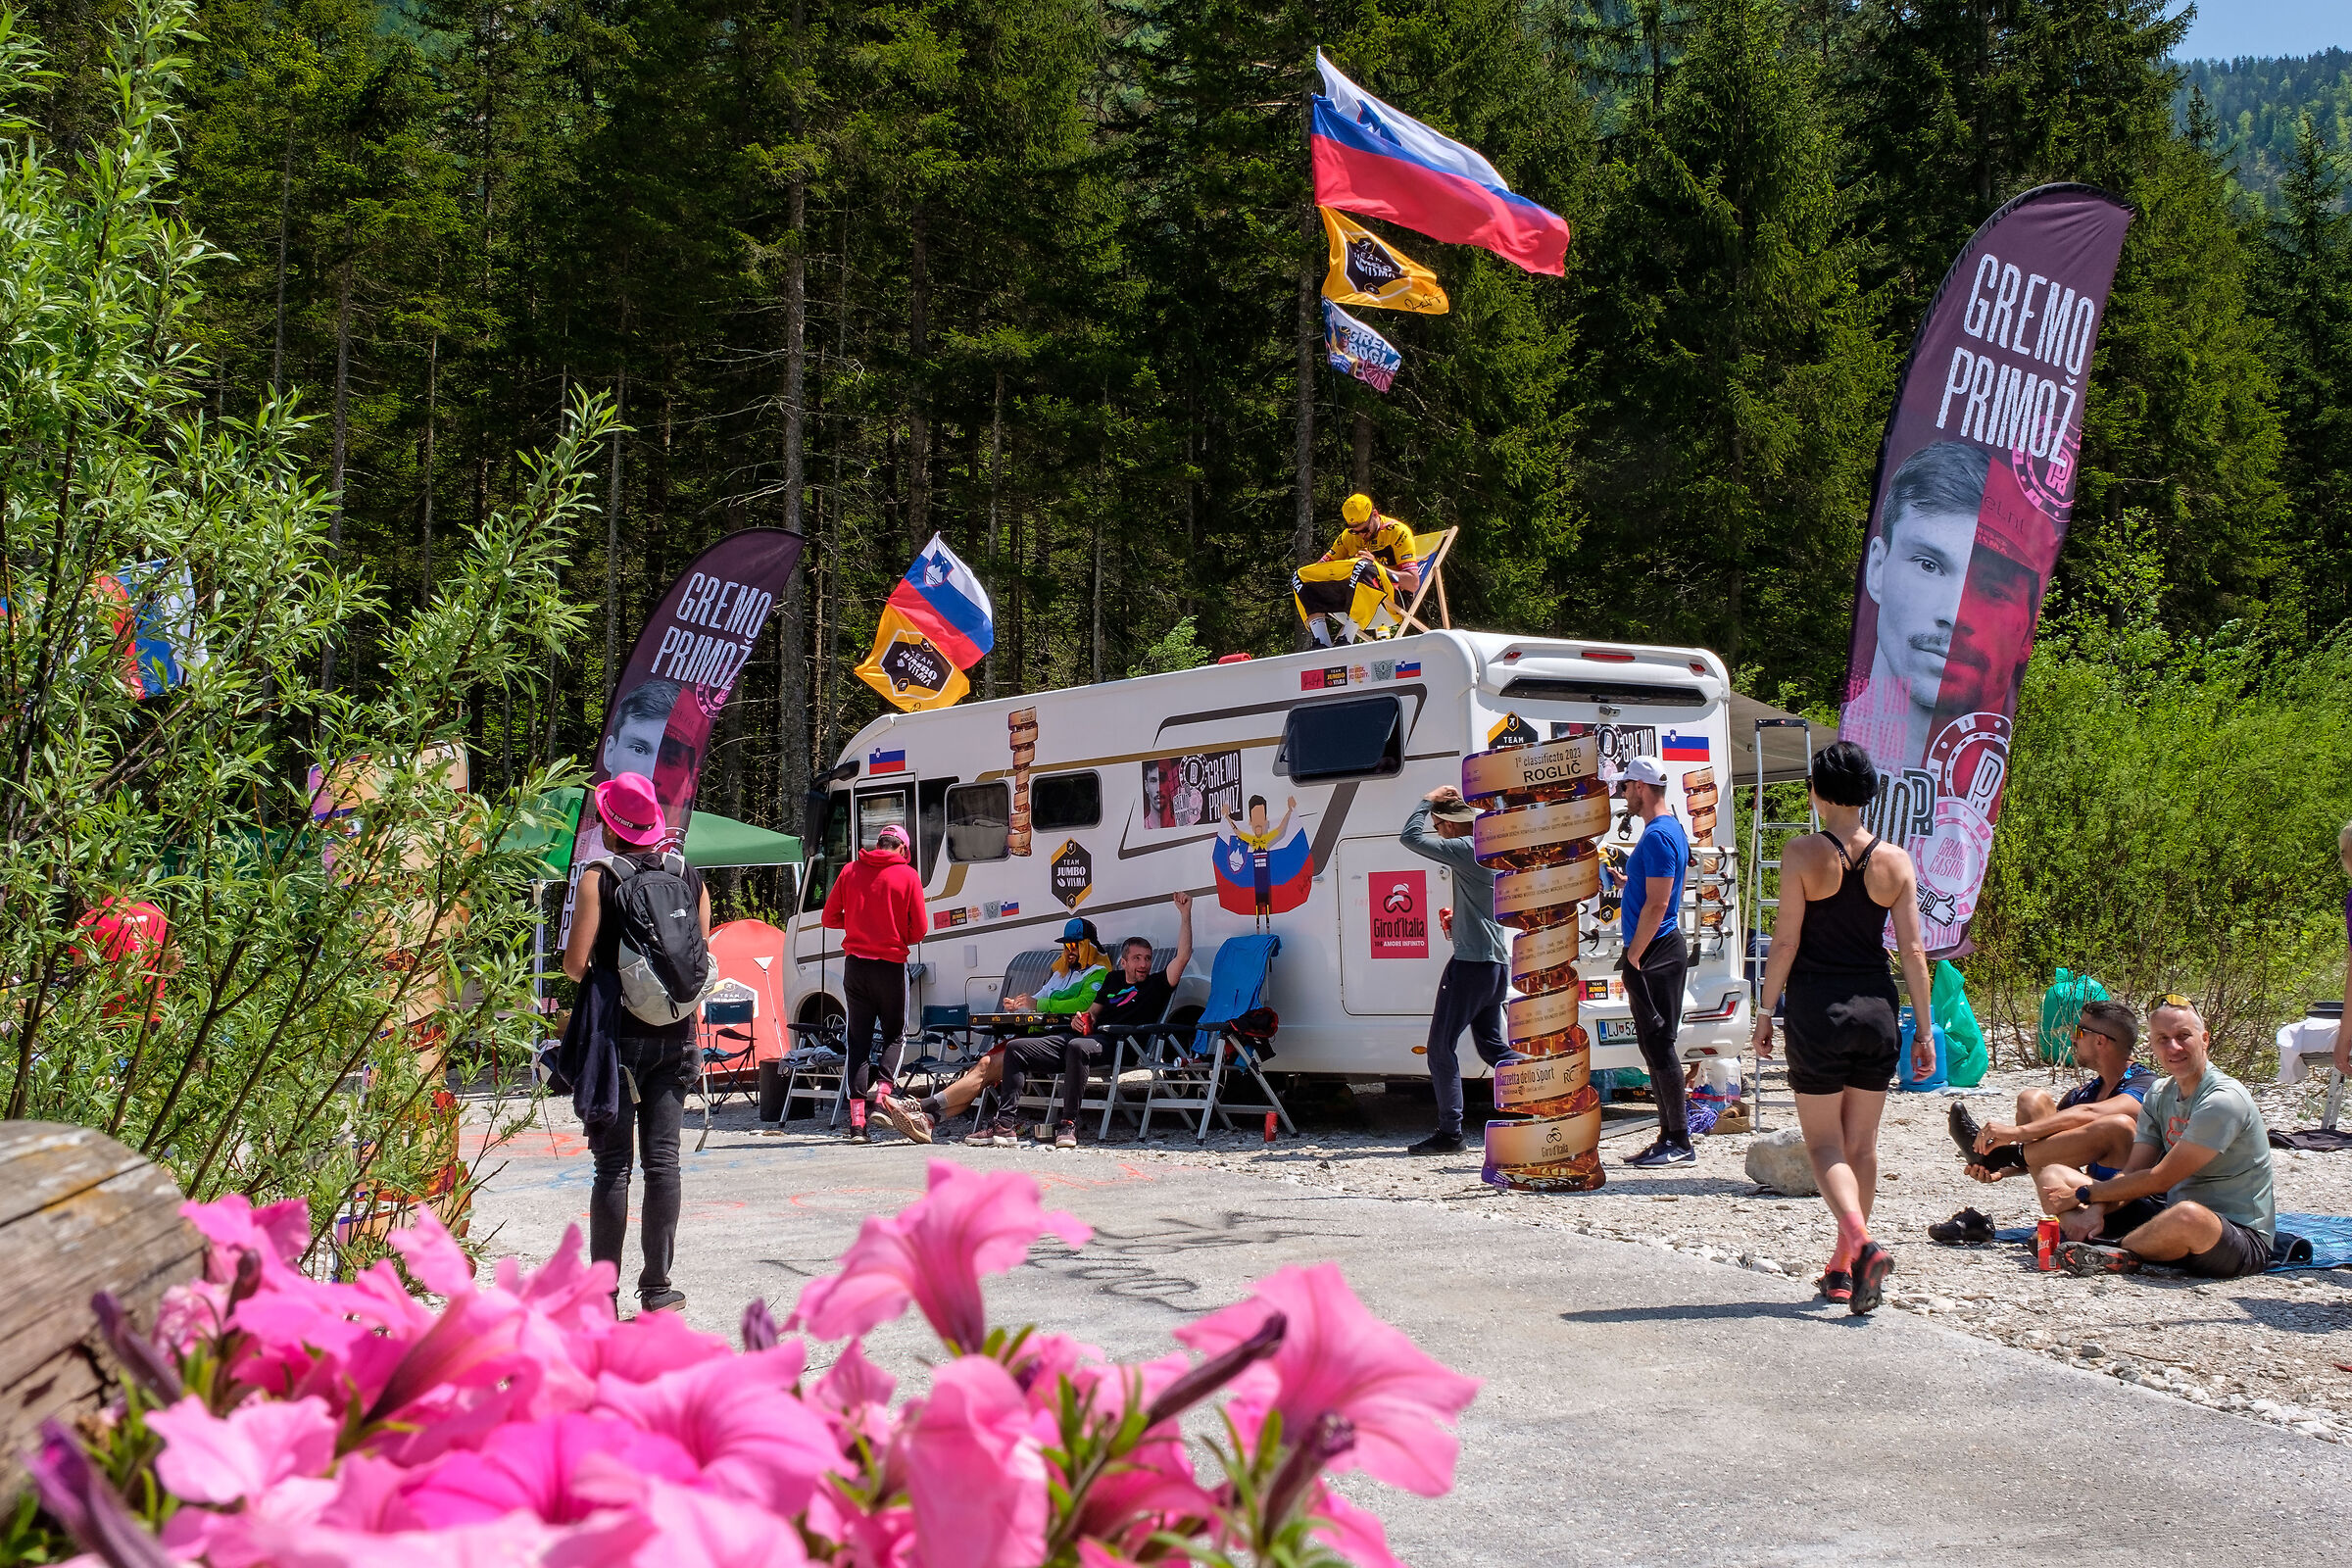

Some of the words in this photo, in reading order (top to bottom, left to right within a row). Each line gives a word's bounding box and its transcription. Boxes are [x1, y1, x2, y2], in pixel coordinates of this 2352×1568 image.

[1963, 253, 2095, 376] GREMO
[1936, 346, 2078, 468] PRIMOŽ
[1348, 560, 1369, 588] HEMA
[676, 572, 772, 639] GREMO
[651, 626, 753, 691] PRIMOŽ
[899, 650, 938, 681] JUMBO
[907, 662, 932, 687] VISMA
[1523, 752, 1564, 766] classificato
[1565, 747, 1582, 760] 2023
[1206, 753, 1239, 789] GREMO
[1523, 760, 1582, 783] ROGLIČ
[1208, 781, 1240, 820] PRIMOŽ
[1056, 866, 1086, 876] JUMBO
[1929, 856, 1965, 881] CASINO
[1066, 877, 1086, 887] VISMA
[1374, 917, 1393, 938] Giro
[1394, 916, 1425, 938] d'Italia
[1536, 1066, 1555, 1083] Sport
